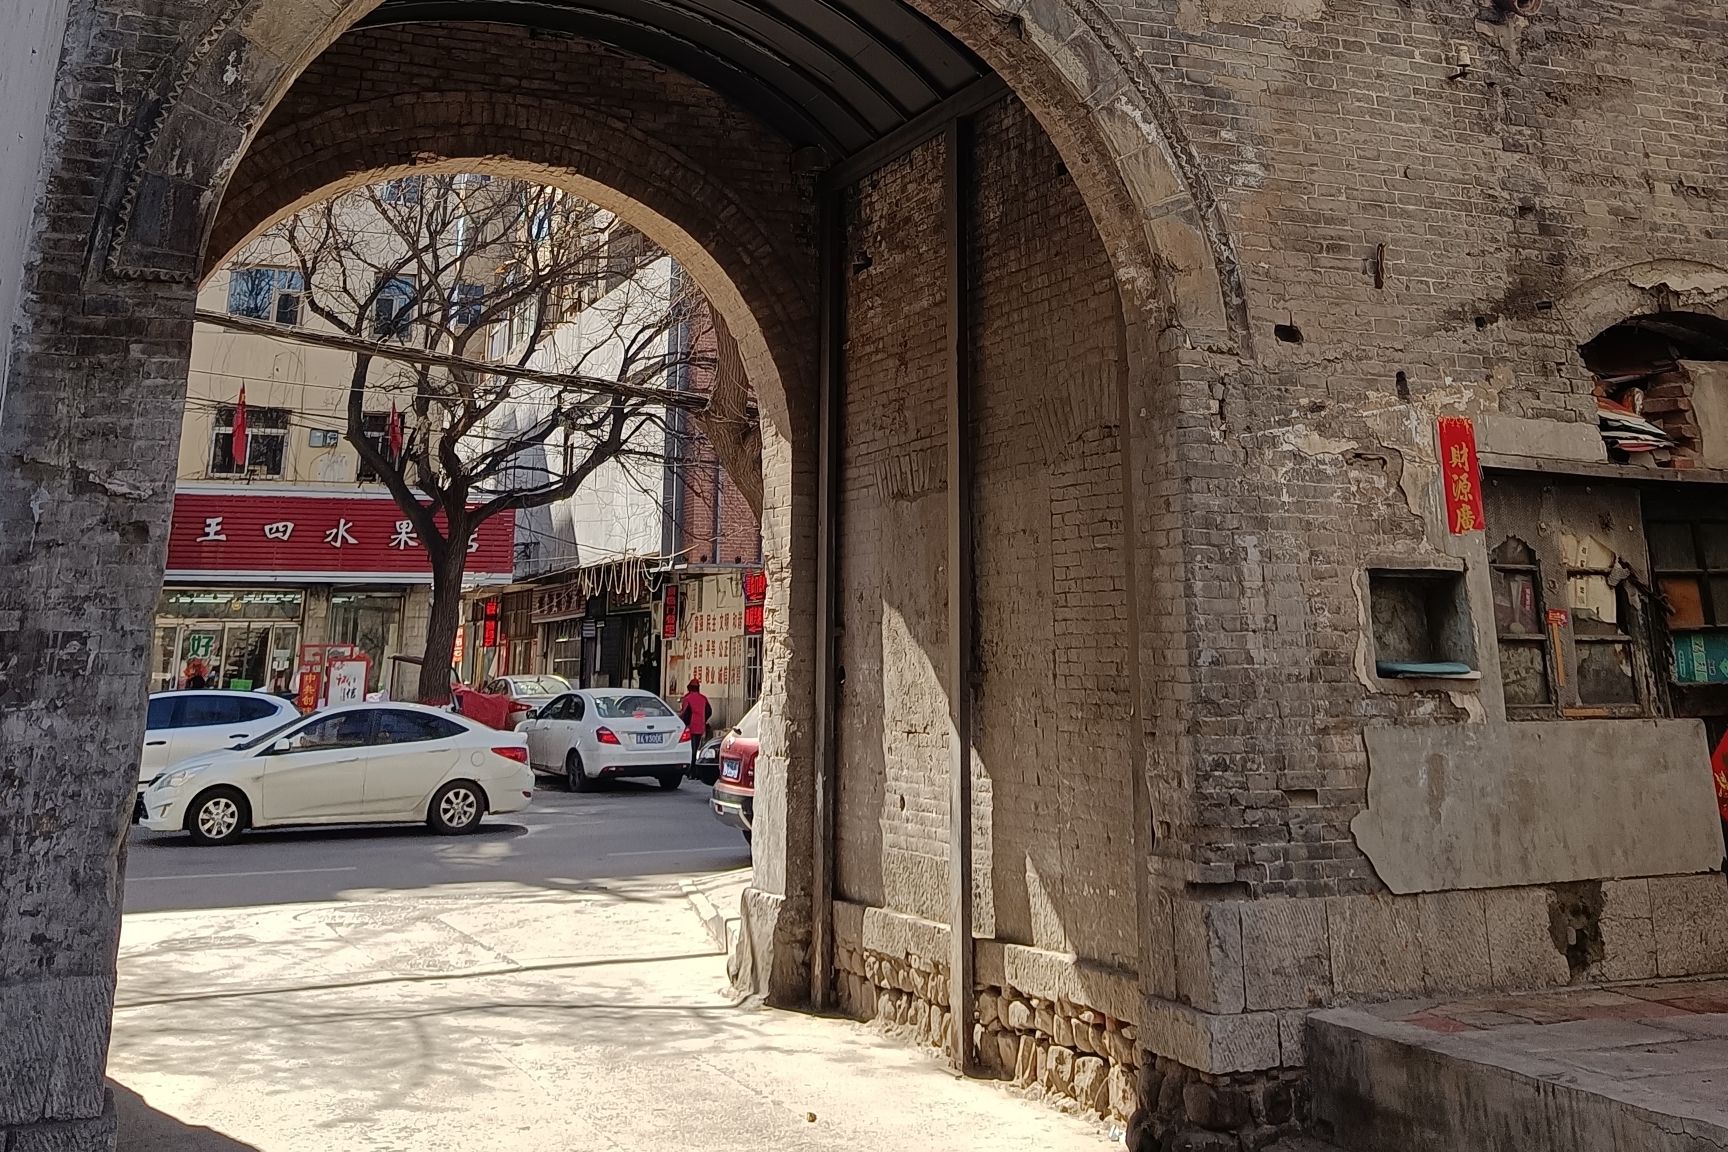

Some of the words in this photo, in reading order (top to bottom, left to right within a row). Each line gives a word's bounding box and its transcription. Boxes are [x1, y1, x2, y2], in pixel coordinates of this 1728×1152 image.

[1449, 442, 1475, 533] 財源廣
[196, 516, 479, 554] 王四水果
[189, 635, 215, 658] 好
